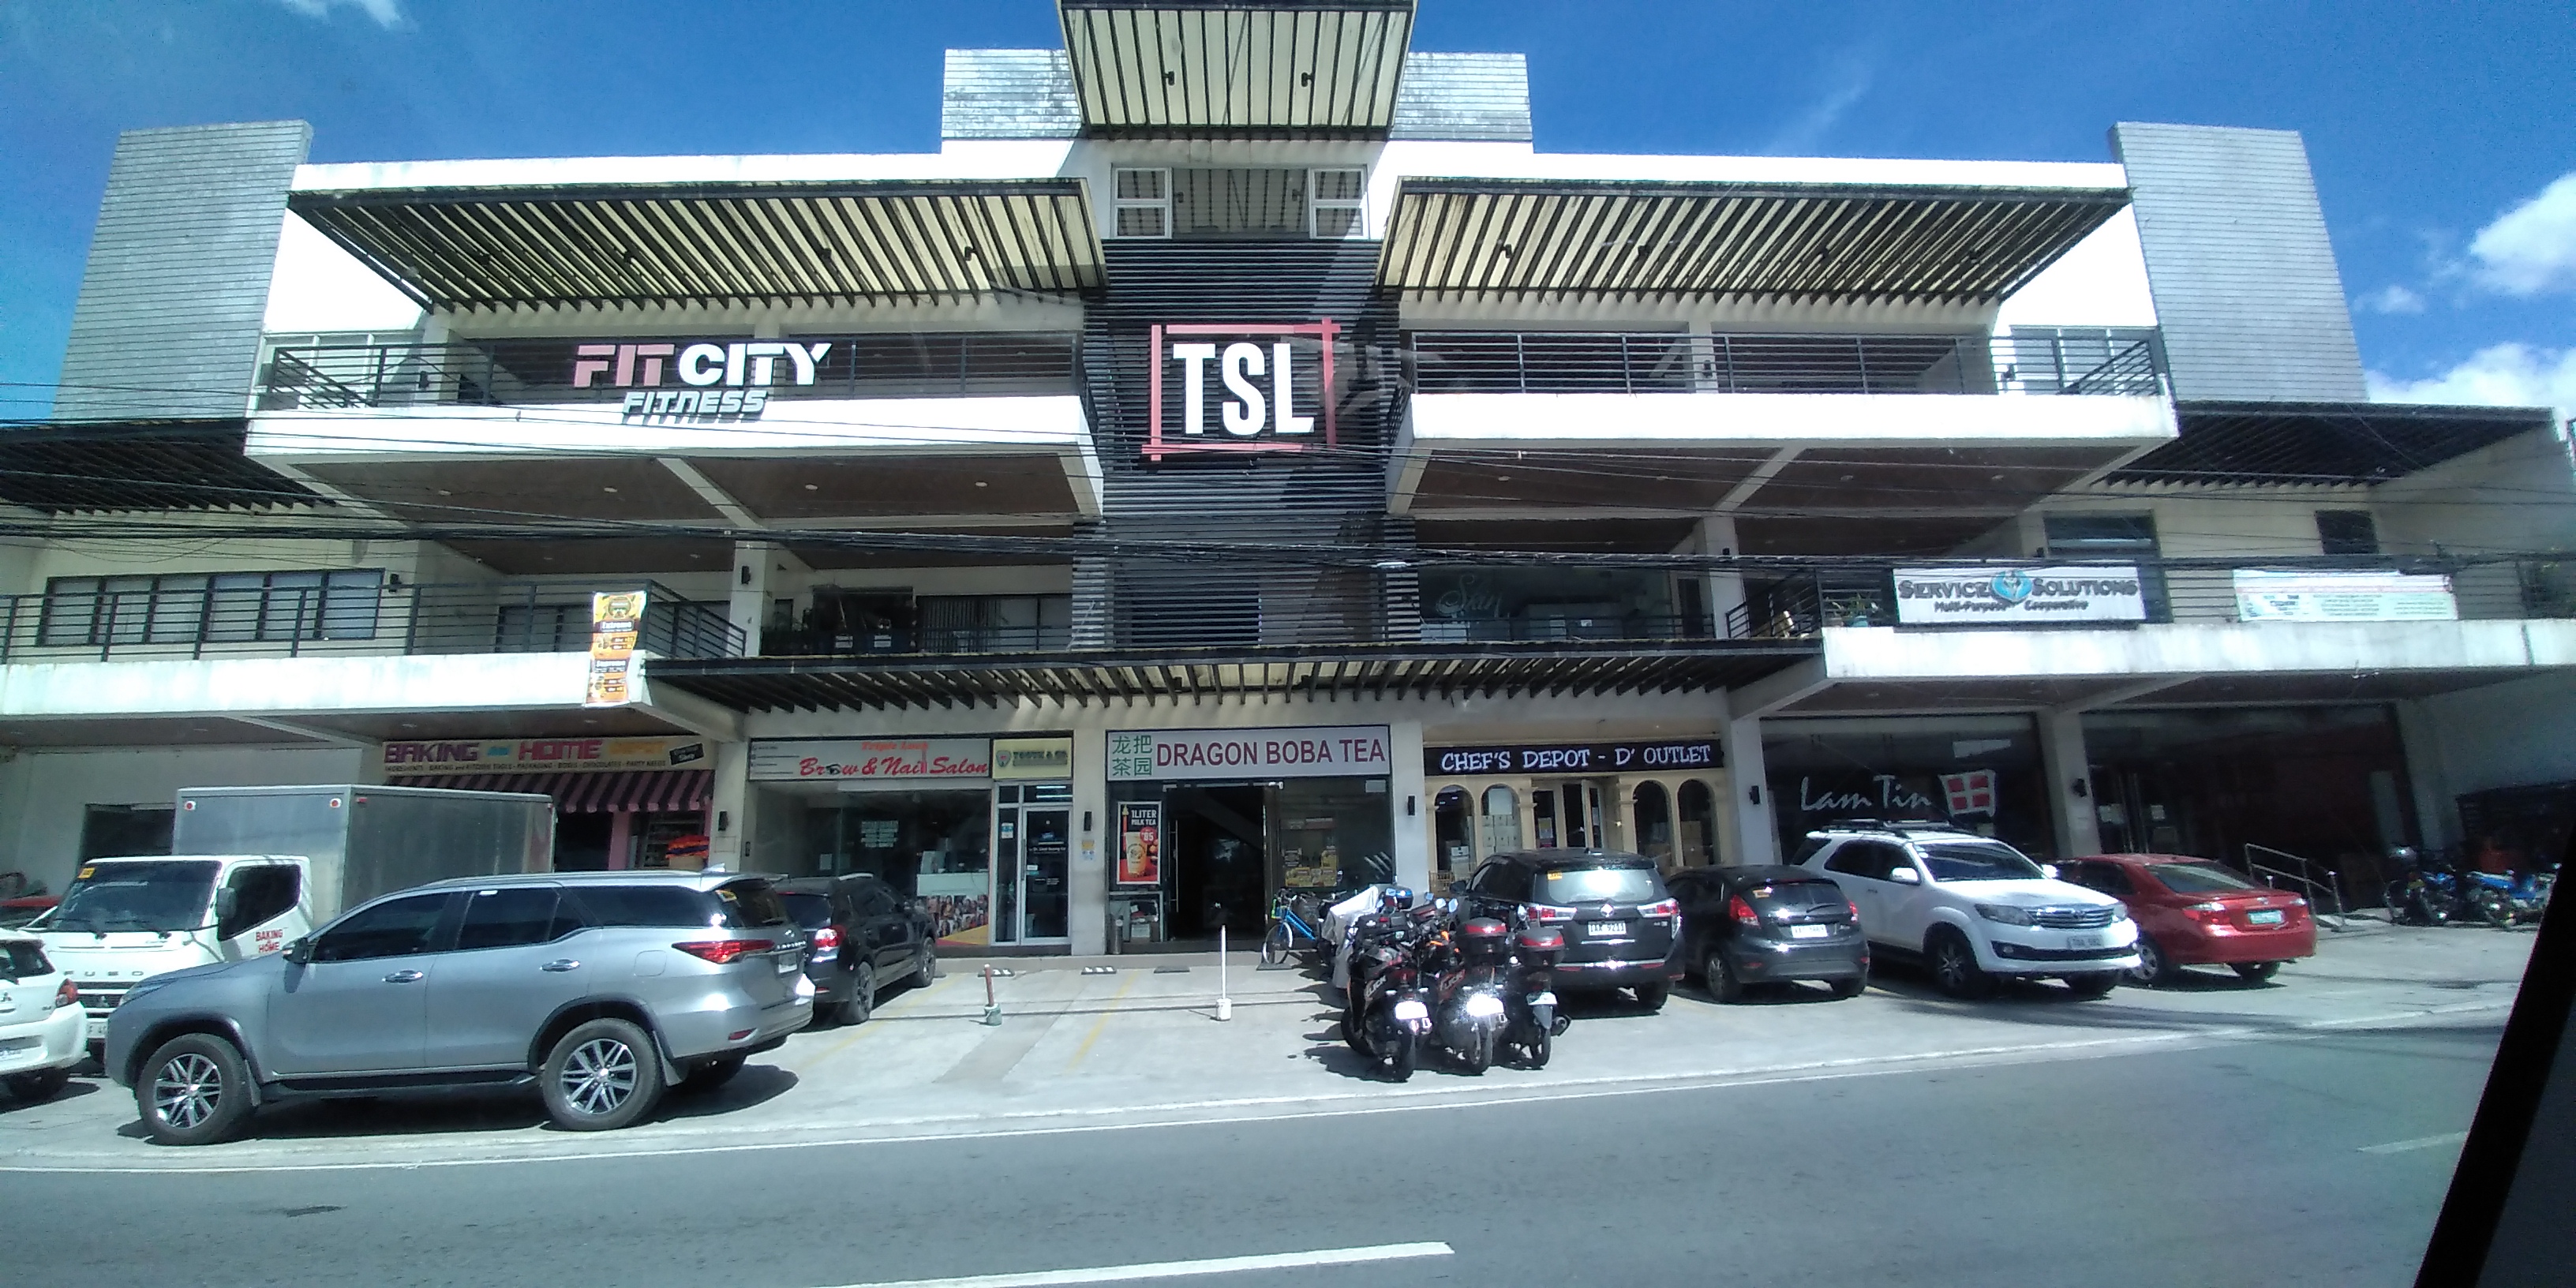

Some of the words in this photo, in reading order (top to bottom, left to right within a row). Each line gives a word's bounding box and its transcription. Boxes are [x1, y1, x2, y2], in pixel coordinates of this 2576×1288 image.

[574, 344, 675, 388] FIT
[679, 343, 833, 386] CITY
[1173, 343, 1315, 435] TSL
[623, 390, 768, 414] FITNESS
[384, 743, 479, 762] BAKING
[519, 739, 603, 760] HOME
[1157, 742, 1258, 766] DRAGON
[1266, 739, 1333, 764] BOBA
[1339, 739, 1385, 762] TEA
[1442, 751, 1511, 771] CHEF'S
[1522, 748, 1589, 769] DEPOT
[1644, 745, 1710, 764] OUTLET
[930, 756, 988, 775] Salon
[1800, 776, 1872, 811] Lam
[1873, 774, 1931, 808] Tin
[256, 929, 283, 942] BAKING
[259, 942, 279, 953] HOME
